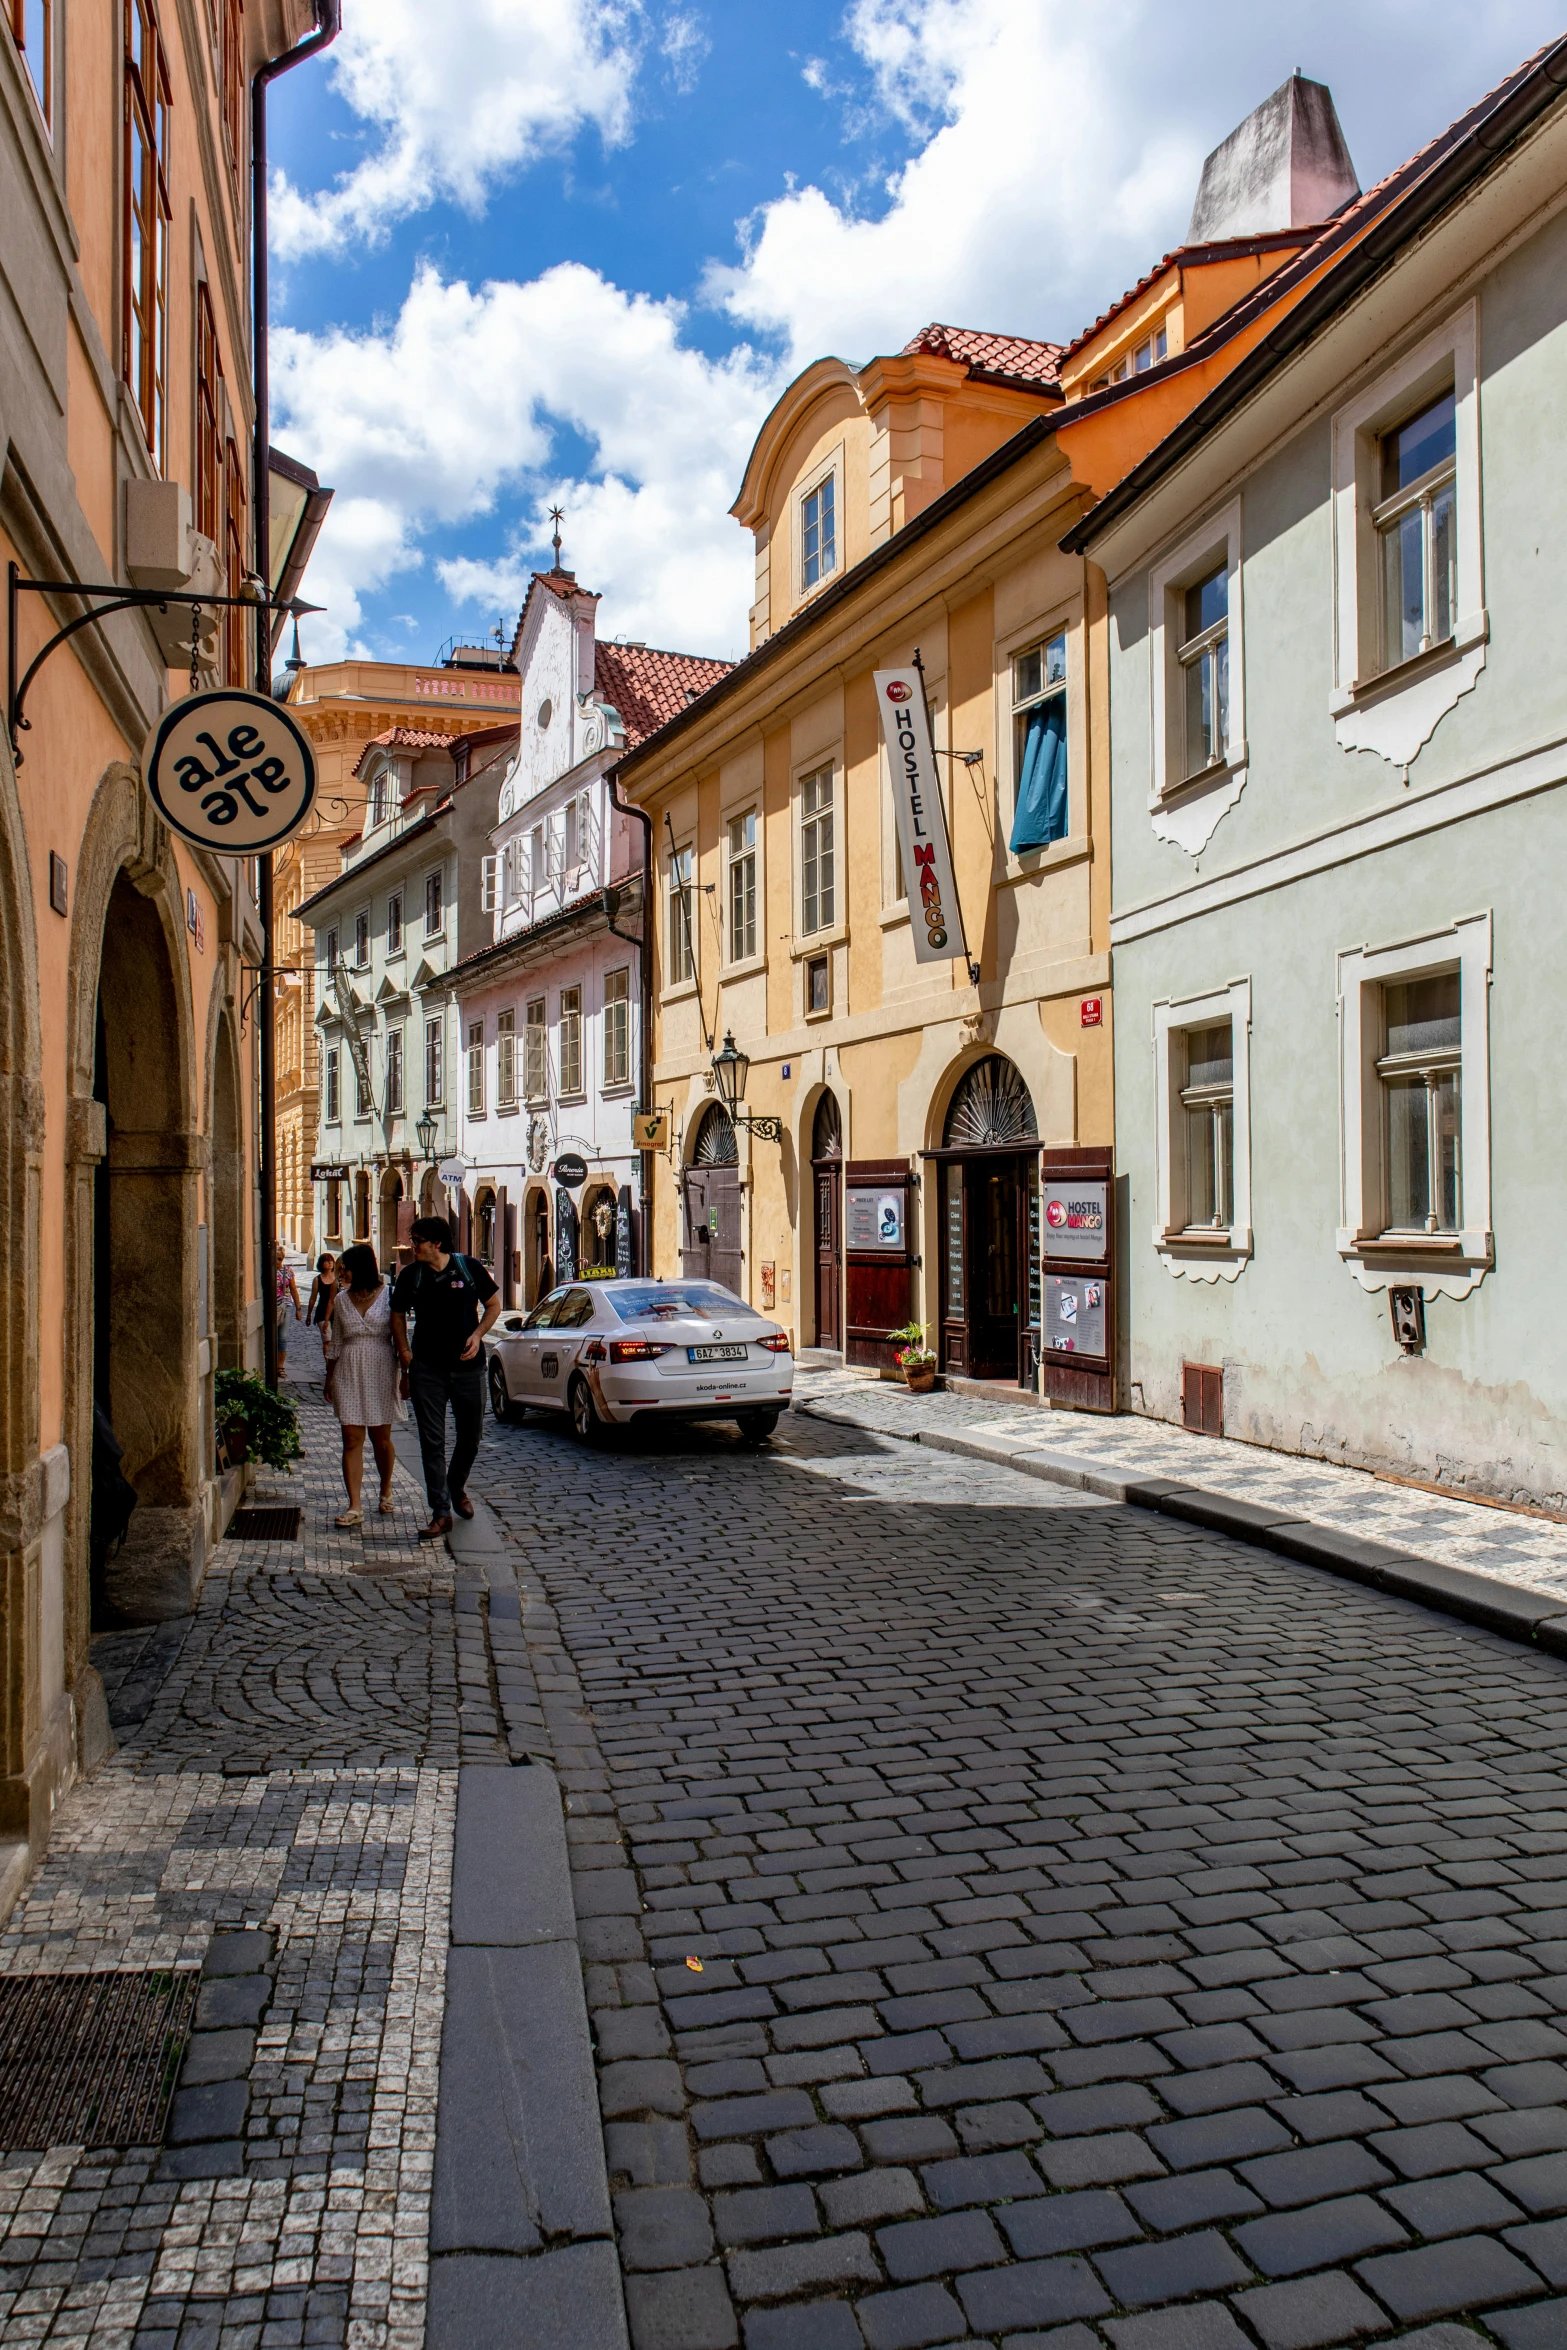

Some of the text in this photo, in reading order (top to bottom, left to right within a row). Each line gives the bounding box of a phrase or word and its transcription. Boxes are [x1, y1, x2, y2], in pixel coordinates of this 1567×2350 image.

[173, 724, 266, 793] ale
[200, 756, 291, 826] ale
[895, 709, 948, 950] HOSTEL MANGO
[342, 1008, 356, 1032] Suites
[441, 1174, 462, 1182] ATM
[1068, 1202, 1102, 1214] HOSTEL
[1067, 1214, 1103, 1229] MANGO
[584, 1267, 614, 1277] TAXI
[696, 1348, 714, 1358] 6AZ
[720, 1346, 742, 1357] 3834
[696, 1382, 747, 1391] skoda-online.cz
